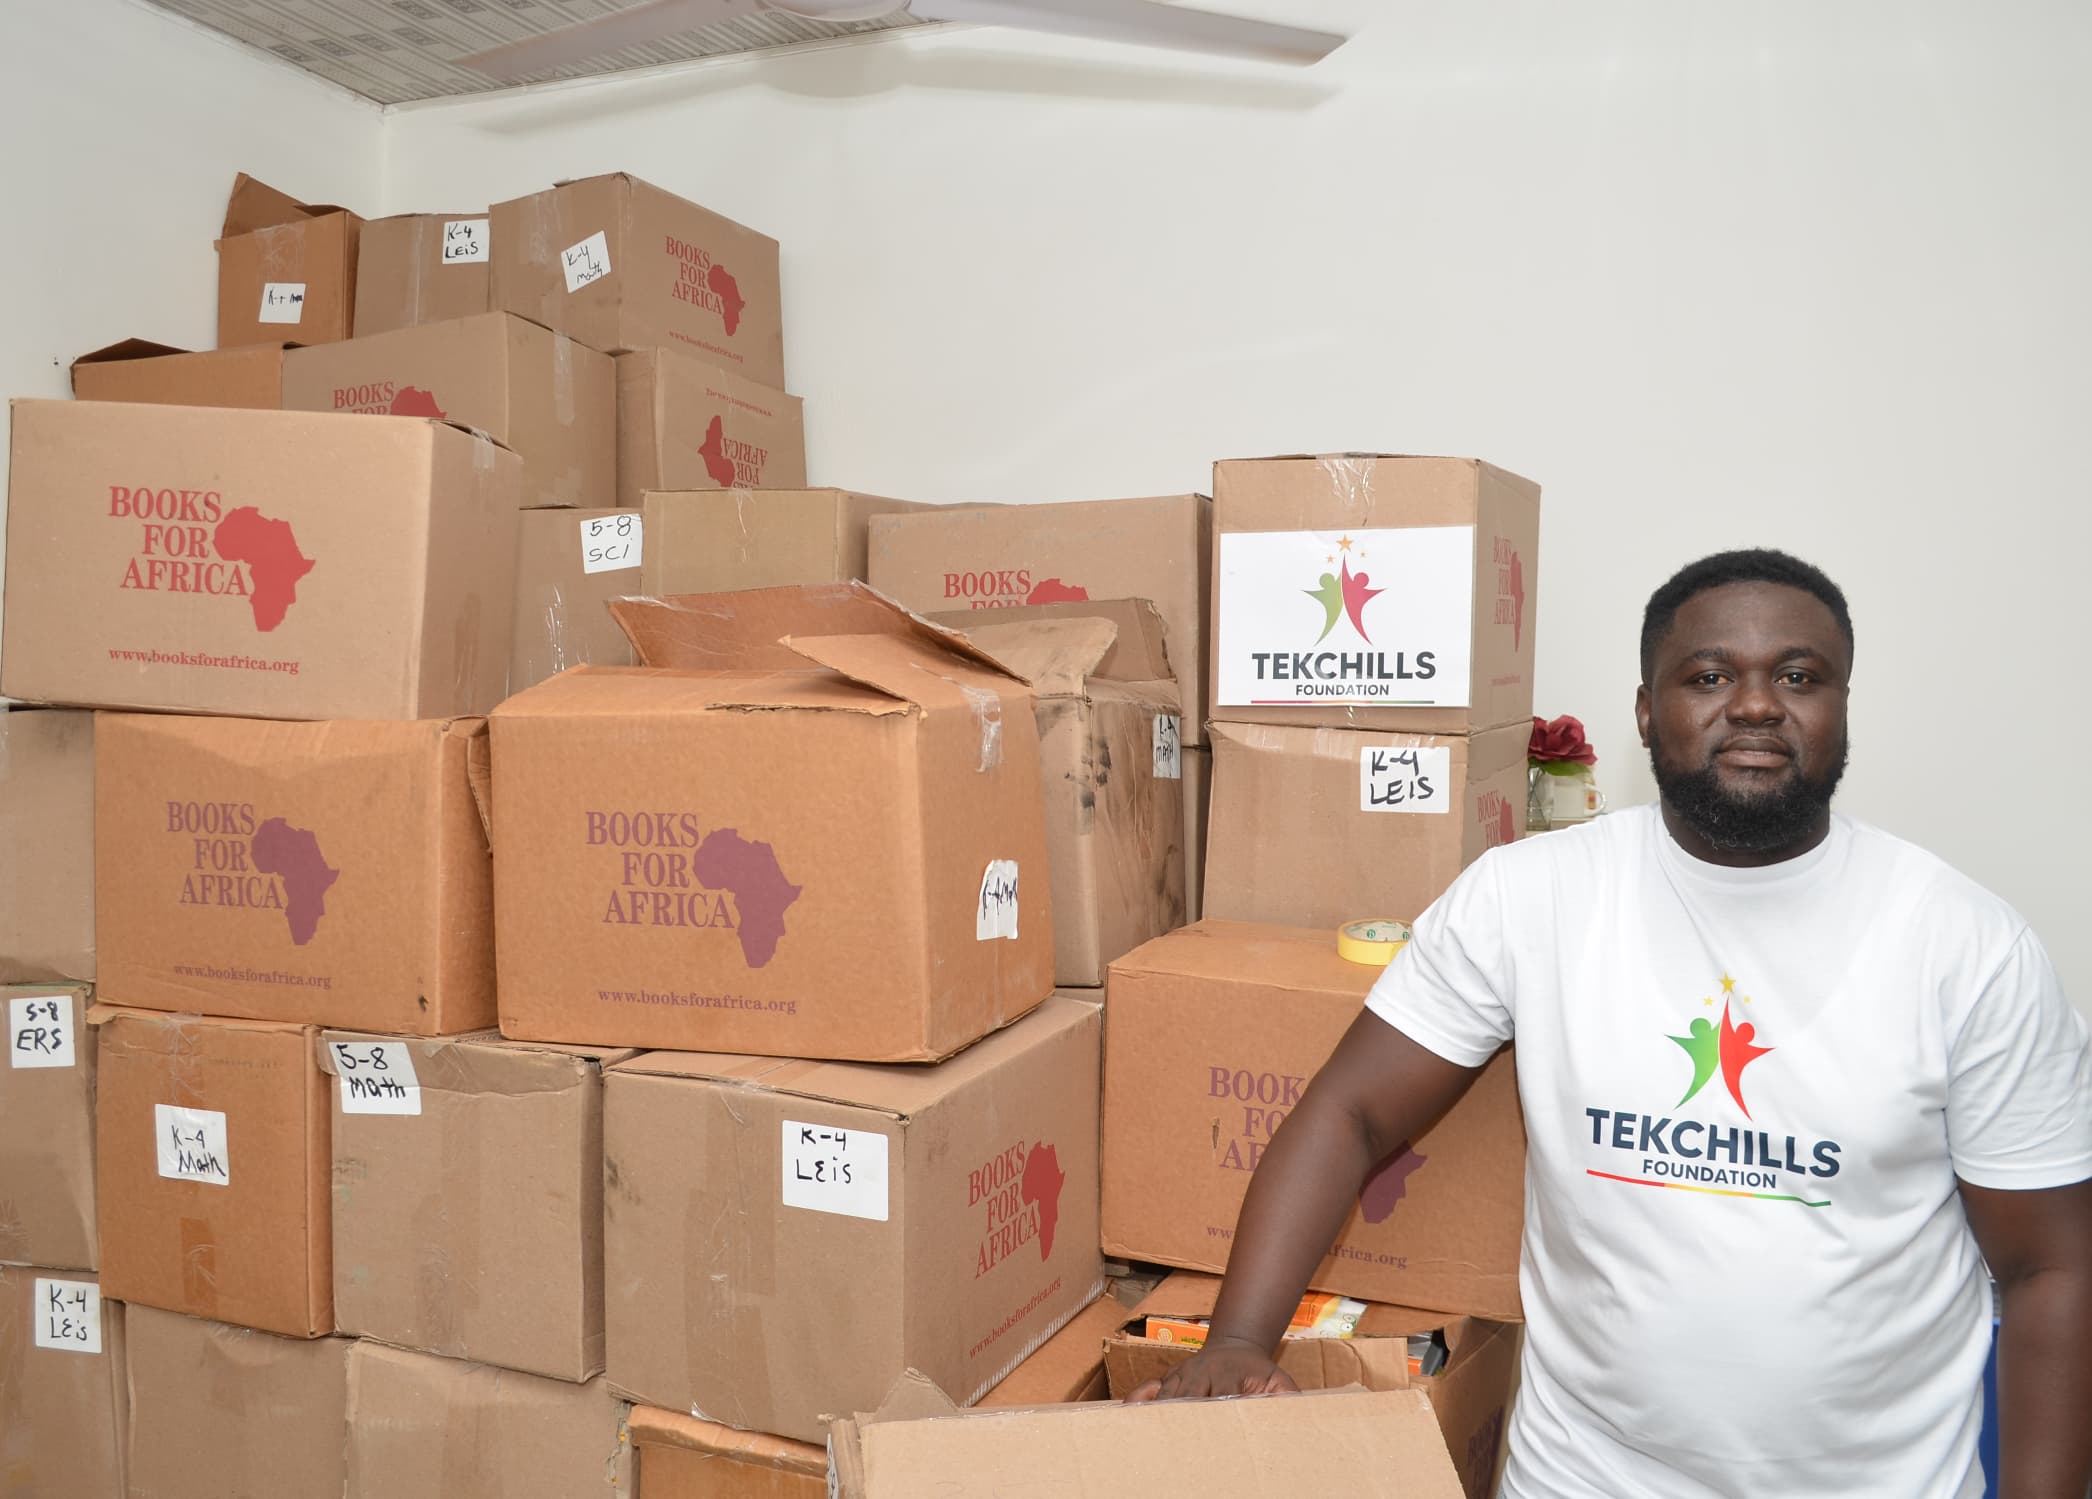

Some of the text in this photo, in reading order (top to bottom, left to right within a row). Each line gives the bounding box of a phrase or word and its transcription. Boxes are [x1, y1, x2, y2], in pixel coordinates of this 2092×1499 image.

[448, 224, 473, 241] K-4
[666, 236, 711, 269] BOOKS
[680, 262, 707, 289] FOR
[672, 280, 722, 315] AFRICA
[333, 382, 395, 409] BOOKS
[723, 438, 768, 467] AFRICA
[735, 462, 760, 485] FOR
[108, 486, 222, 523] BOOKS
[142, 524, 210, 558] FOR
[590, 515, 632, 537] 5-8
[120, 557, 249, 596] AFRICA
[943, 569, 1031, 598] BOOKS
[109, 649, 299, 675] www.booksforafrica.org
[1251, 651, 1436, 680] TEKCHILLS
[1295, 684, 1390, 696] FOUNDATION
[1371, 750, 1420, 777] K-4
[167, 801, 256, 836] BOOKS
[585, 811, 700, 848] BOOKS
[193, 838, 249, 872] FOR
[621, 852, 690, 888] FOR
[179, 873, 284, 909] AFRICA
[602, 889, 736, 929] AFRICA
[174, 965, 332, 990] www.booksforafrica.org
[598, 990, 797, 1015] www.booksforafrica.org
[336, 1044, 389, 1071] 5-8
[1208, 1066, 1305, 1107] BOOK
[801, 1127, 847, 1151] K-4
[1242, 1106, 1286, 1139] FO
[1586, 1107, 1842, 1178] TEKCHILLS
[967, 1140, 1026, 1208] BOOKS
[1643, 1158, 1777, 1189] FOUNDATION
[986, 1182, 1020, 1234] FOR
[974, 1205, 1039, 1280] AFRICA
[49, 1284, 87, 1313] K-4
[969, 1277, 1062, 1360] www.booksforafrica.org
